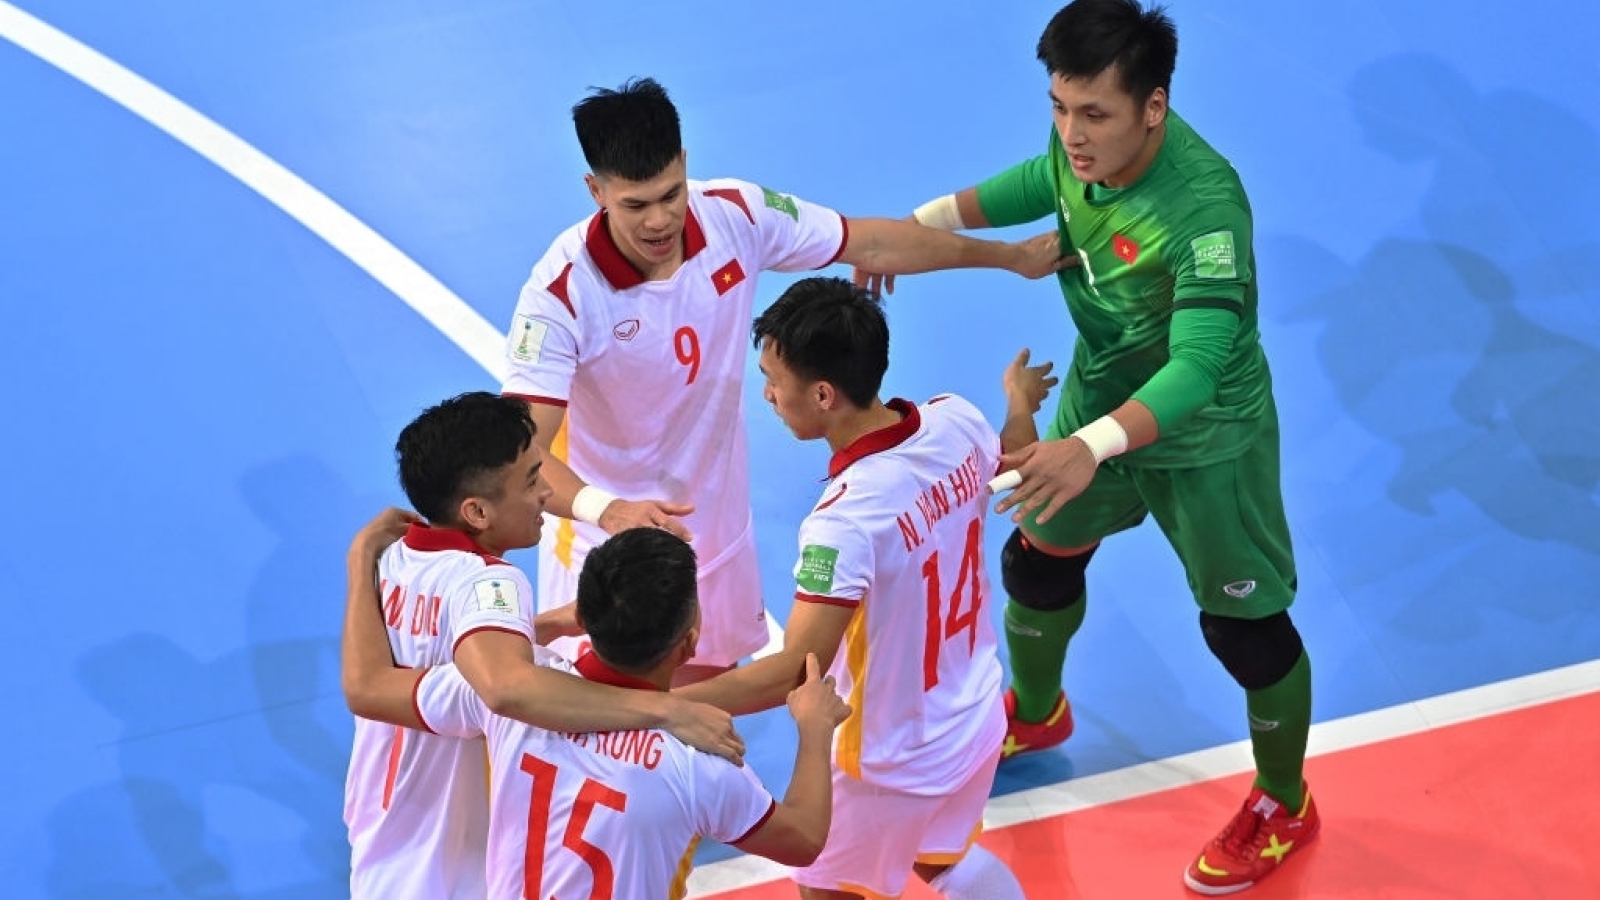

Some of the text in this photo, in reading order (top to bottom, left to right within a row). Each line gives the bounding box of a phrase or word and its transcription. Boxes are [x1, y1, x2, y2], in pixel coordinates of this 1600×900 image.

[673, 326, 701, 386] 9
[896, 511, 925, 552] N.
[922, 516, 982, 693] 14
[520, 752, 627, 900] 15
